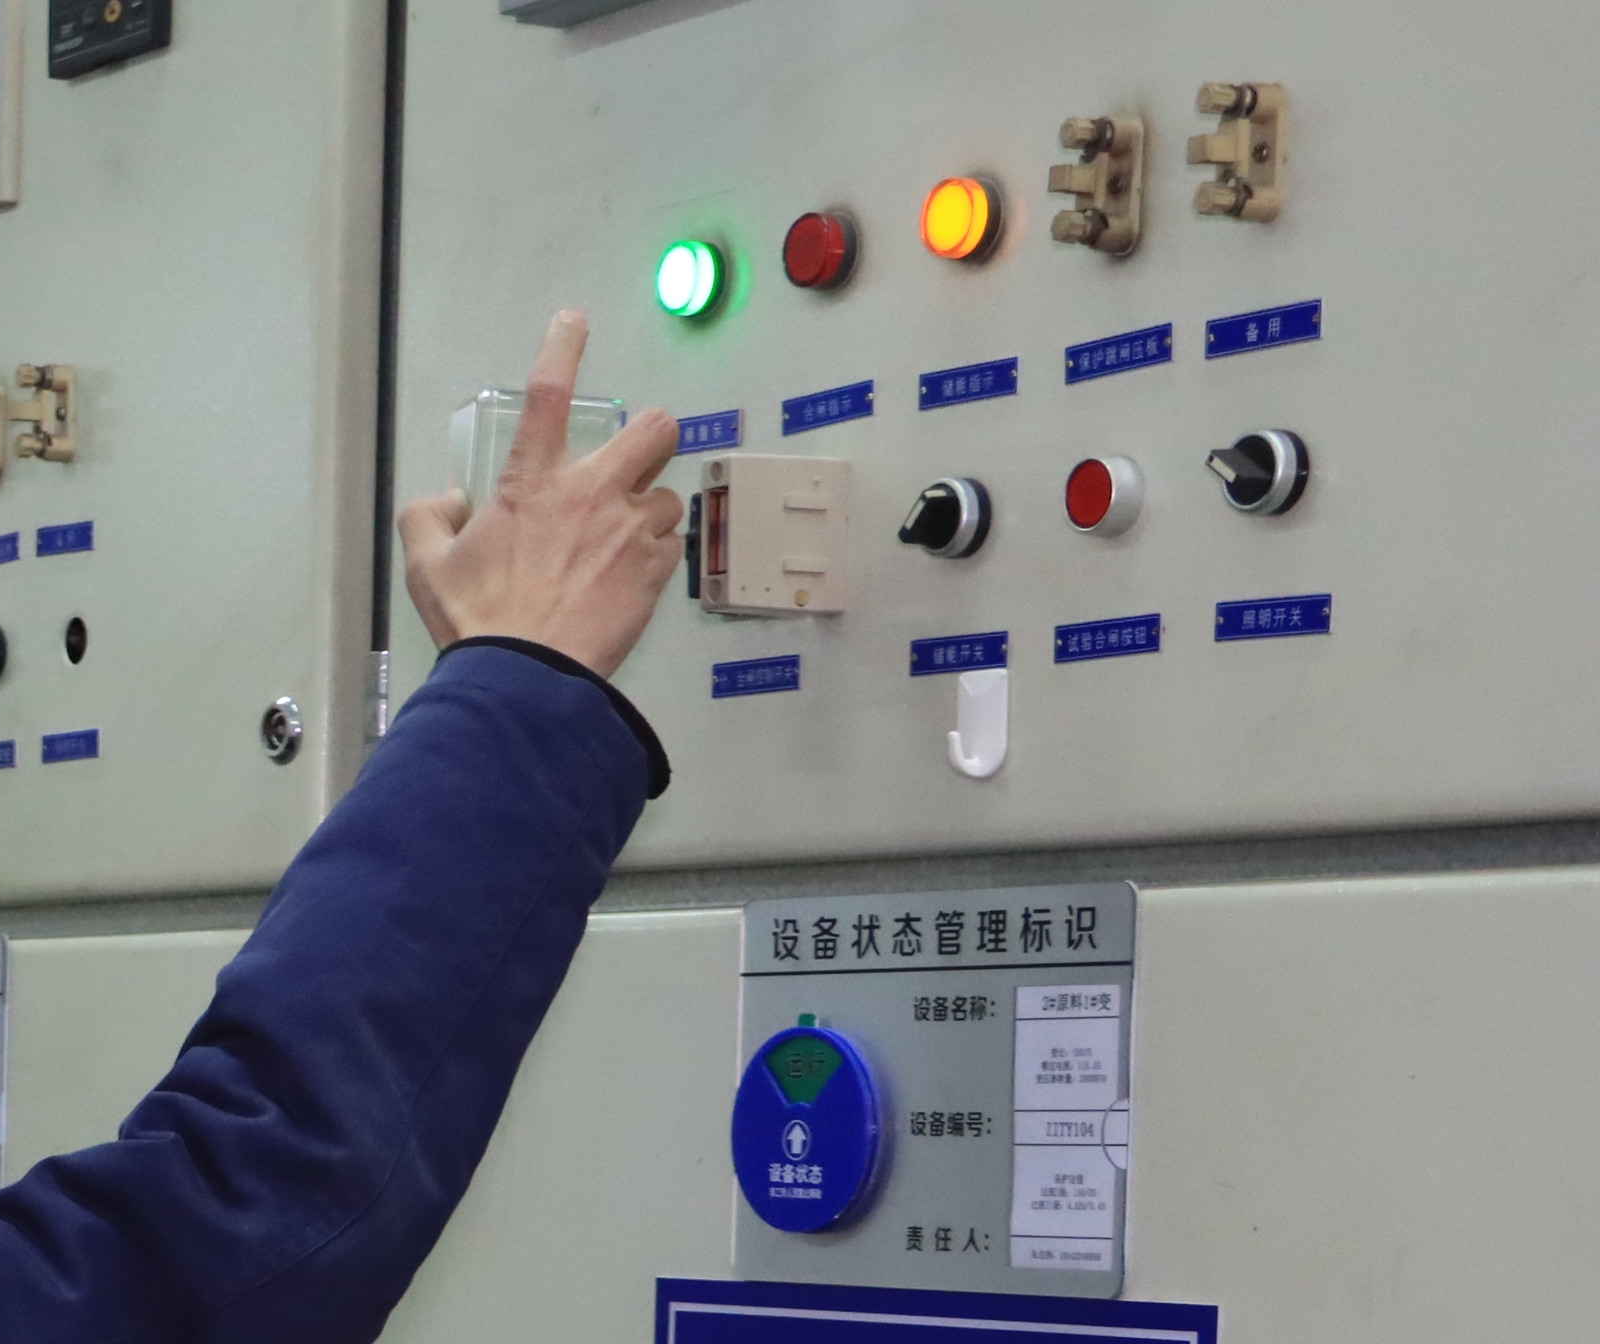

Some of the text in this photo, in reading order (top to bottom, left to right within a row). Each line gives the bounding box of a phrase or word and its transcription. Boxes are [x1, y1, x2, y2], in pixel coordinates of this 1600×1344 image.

[1245, 316, 1282, 343] 备用
[1241, 606, 1303, 630] 照明开关
[1066, 625, 1148, 653] 试验合闸按钮
[933, 642, 986, 665] 储能开关
[771, 905, 1099, 961] 设备状态管理标识
[1042, 992, 1112, 1012] 2#原料1#变
[768, 1162, 823, 1185] 设备状态
